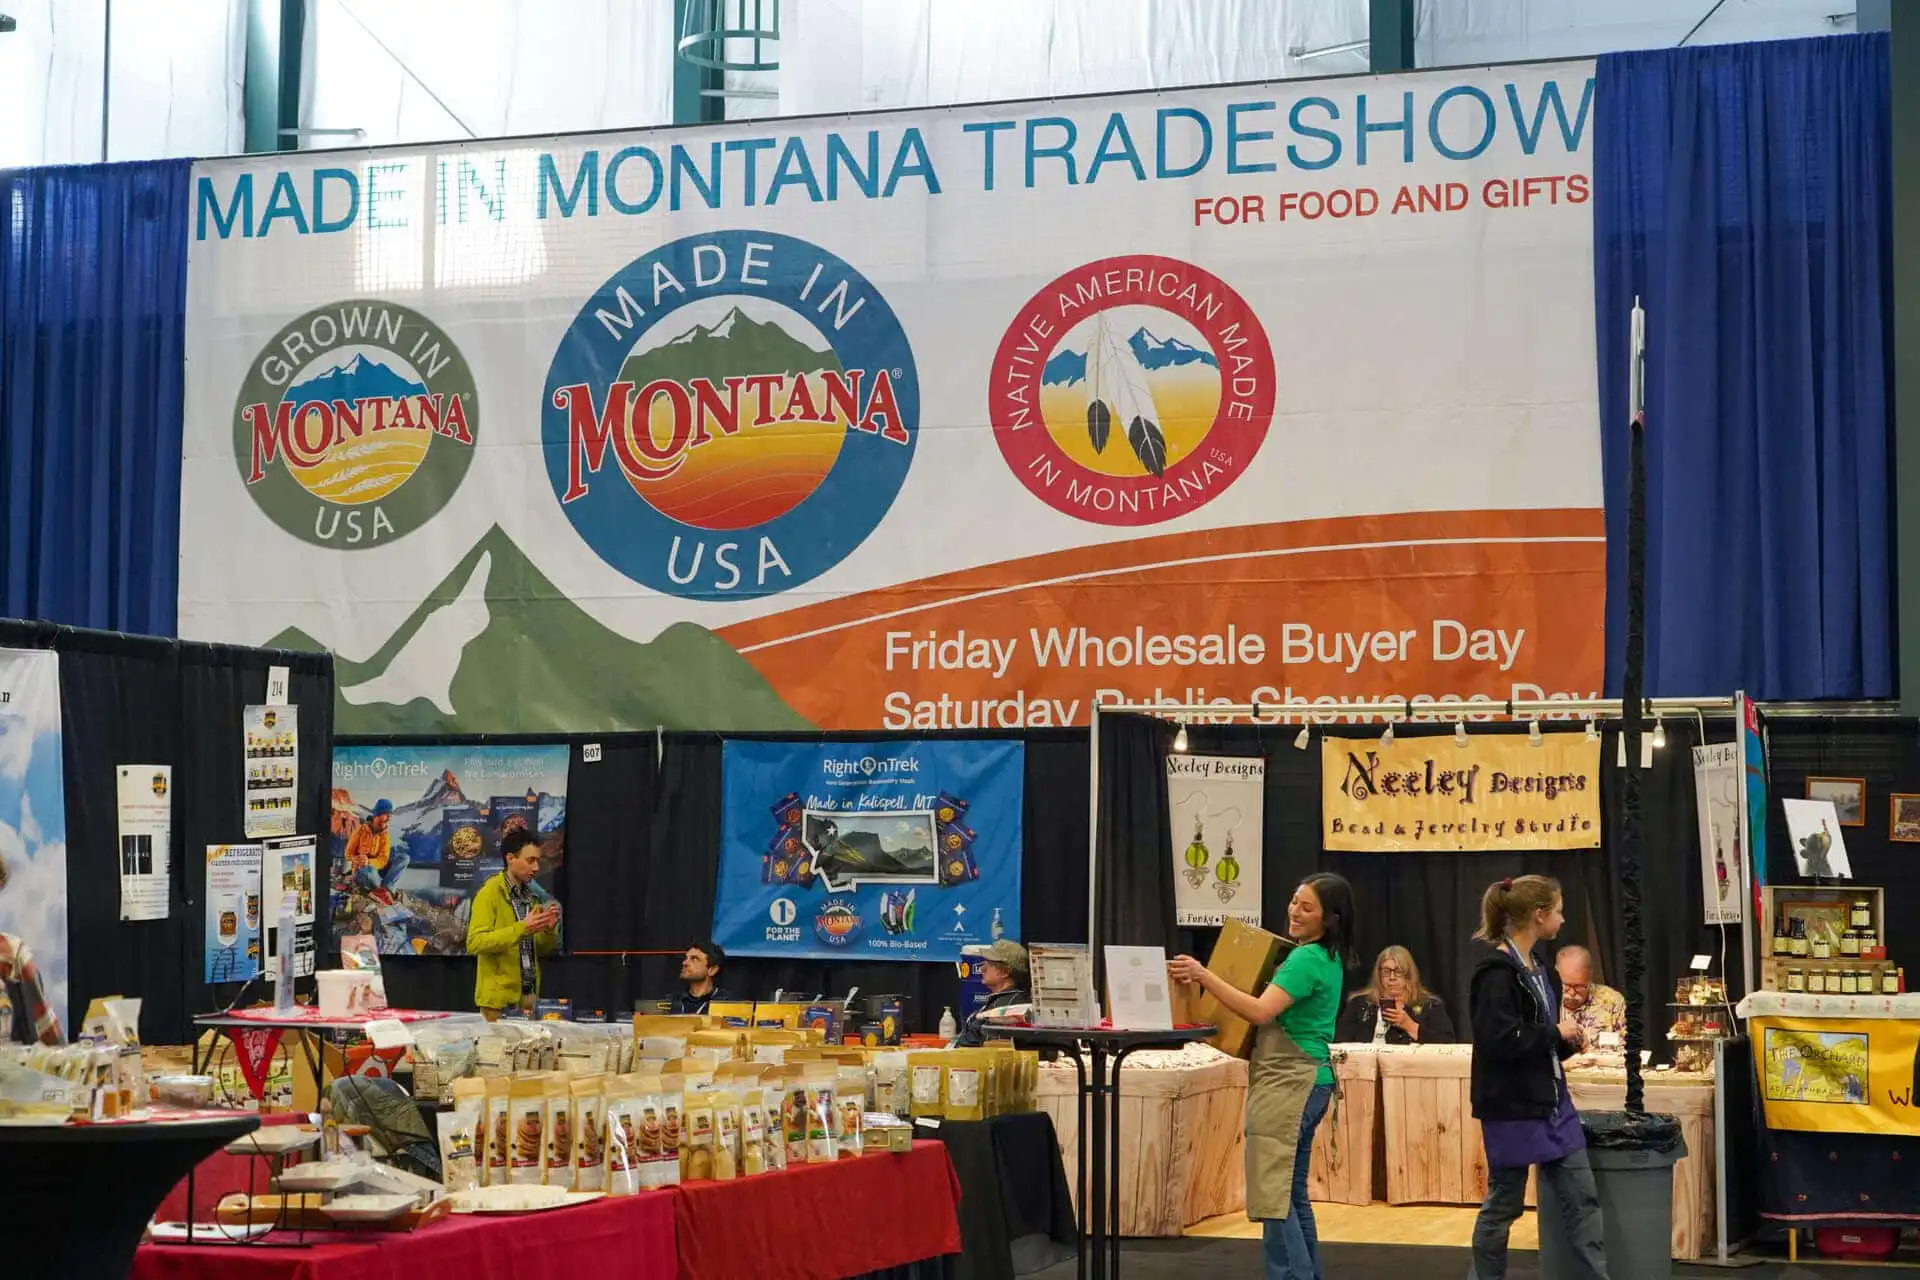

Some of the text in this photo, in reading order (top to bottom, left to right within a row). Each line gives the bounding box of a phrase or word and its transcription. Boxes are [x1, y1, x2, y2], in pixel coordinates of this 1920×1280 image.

[196, 77, 1596, 241] MADE IN MONTANA TRADESHOW
[1195, 173, 1590, 227] FOR FOOD AND GIFTS
[595, 242, 866, 341] MADE IN
[261, 306, 451, 386] GROWN IN
[1007, 268, 1257, 431] NATIVE AMERICAN MADE
[1210, 447, 1233, 466] USA
[1028, 454, 1223, 513] IN MONTANA
[315, 506, 394, 542] USA
[667, 536, 792, 590] USA
[886, 619, 1525, 678] Friday Wholesale Buyer Day
[824, 756, 920, 777] RightOnTrek
[1167, 757, 1264, 780] Neeley Designs
[1340, 751, 1587, 804] Neeley Designs
[806, 793, 838, 811] Made
[842, 797, 853, 809] in
[912, 793, 936, 811] MT
[1331, 817, 1385, 835] Bead
[1414, 817, 1506, 840] Jewelry
[1514, 813, 1592, 834] Studio
[766, 933, 800, 941] PLANET
[869, 939, 888, 947] 100%
[890, 939, 928, 948] Bio-Based
